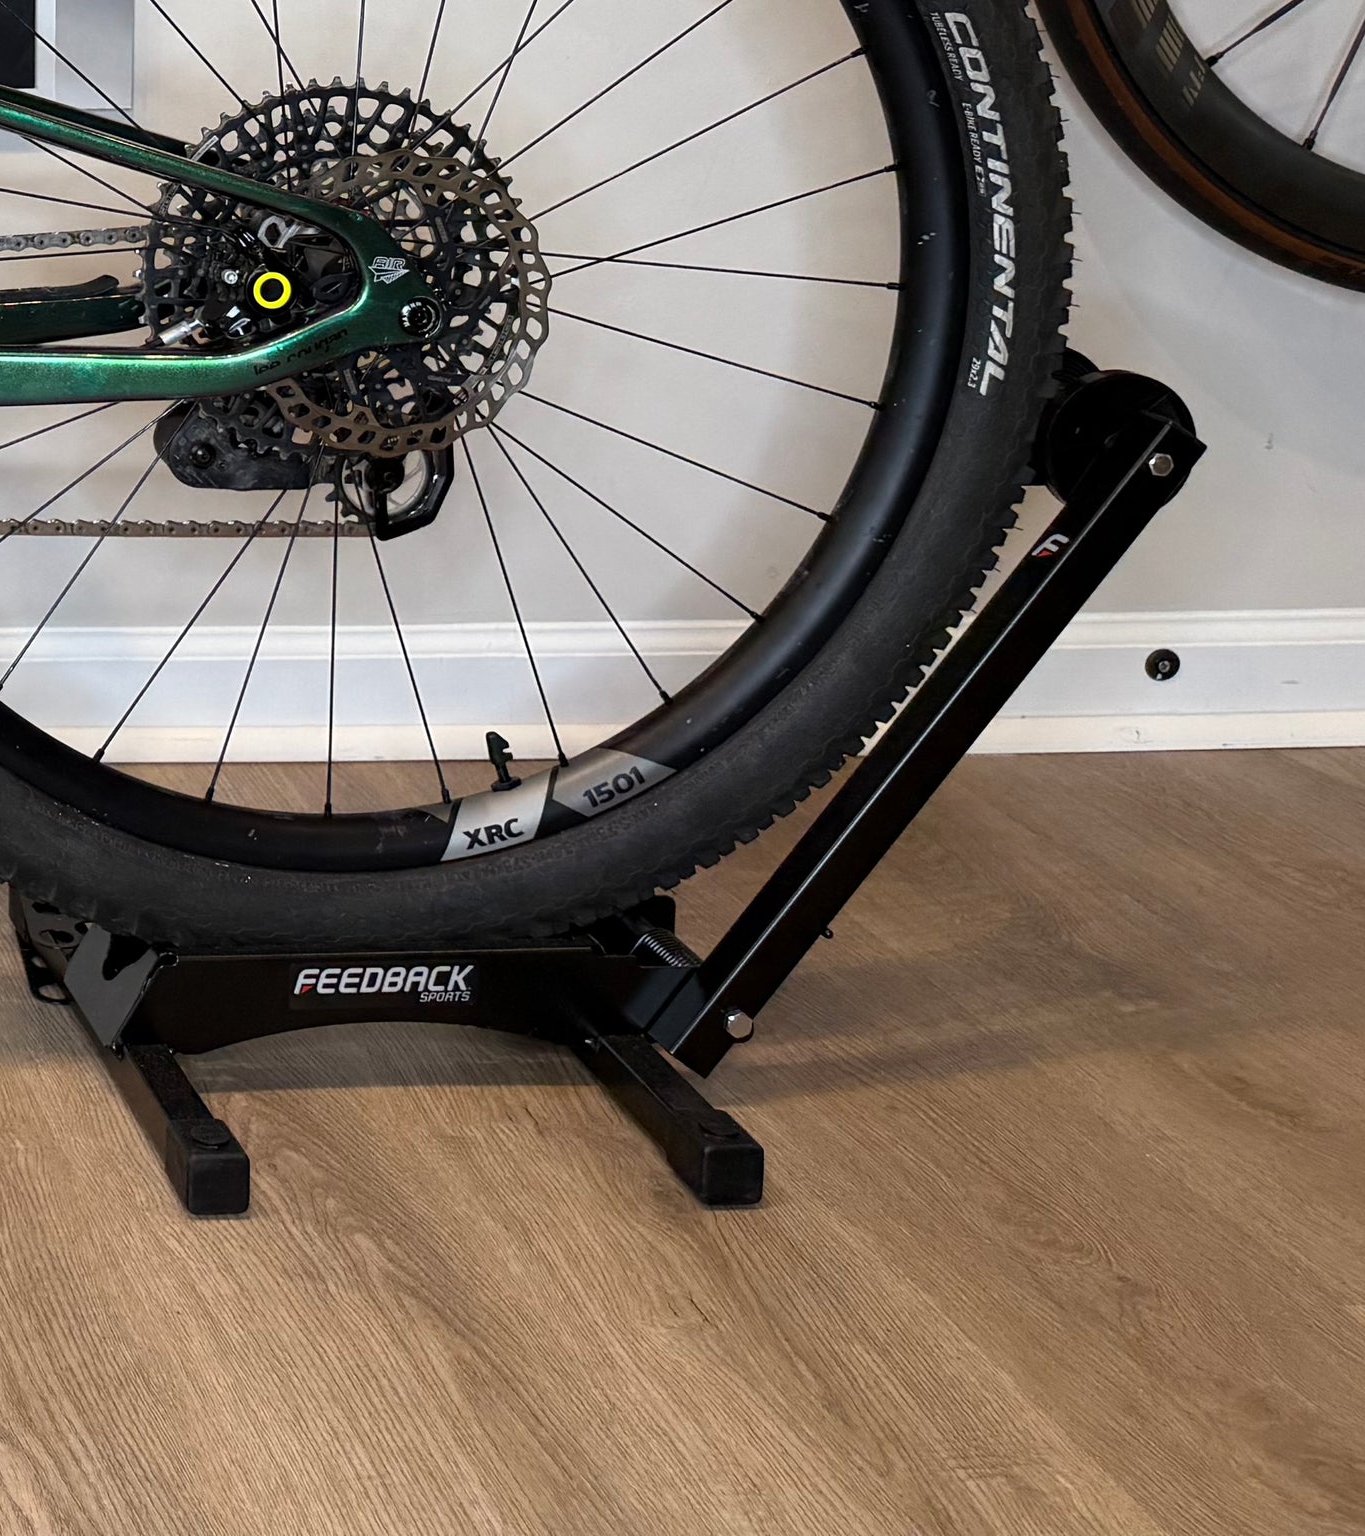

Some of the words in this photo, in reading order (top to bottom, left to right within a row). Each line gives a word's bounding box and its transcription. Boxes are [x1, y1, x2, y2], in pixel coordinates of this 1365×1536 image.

[947, 52, 964, 82] READY
[971, 130, 983, 163] READY
[944, 11, 1016, 397] CONTINENTAL
[582, 766, 646, 808] 1501
[462, 818, 524, 850] XRC
[293, 965, 475, 995] FEEDBACK
[419, 991, 471, 1003] SPORTS
